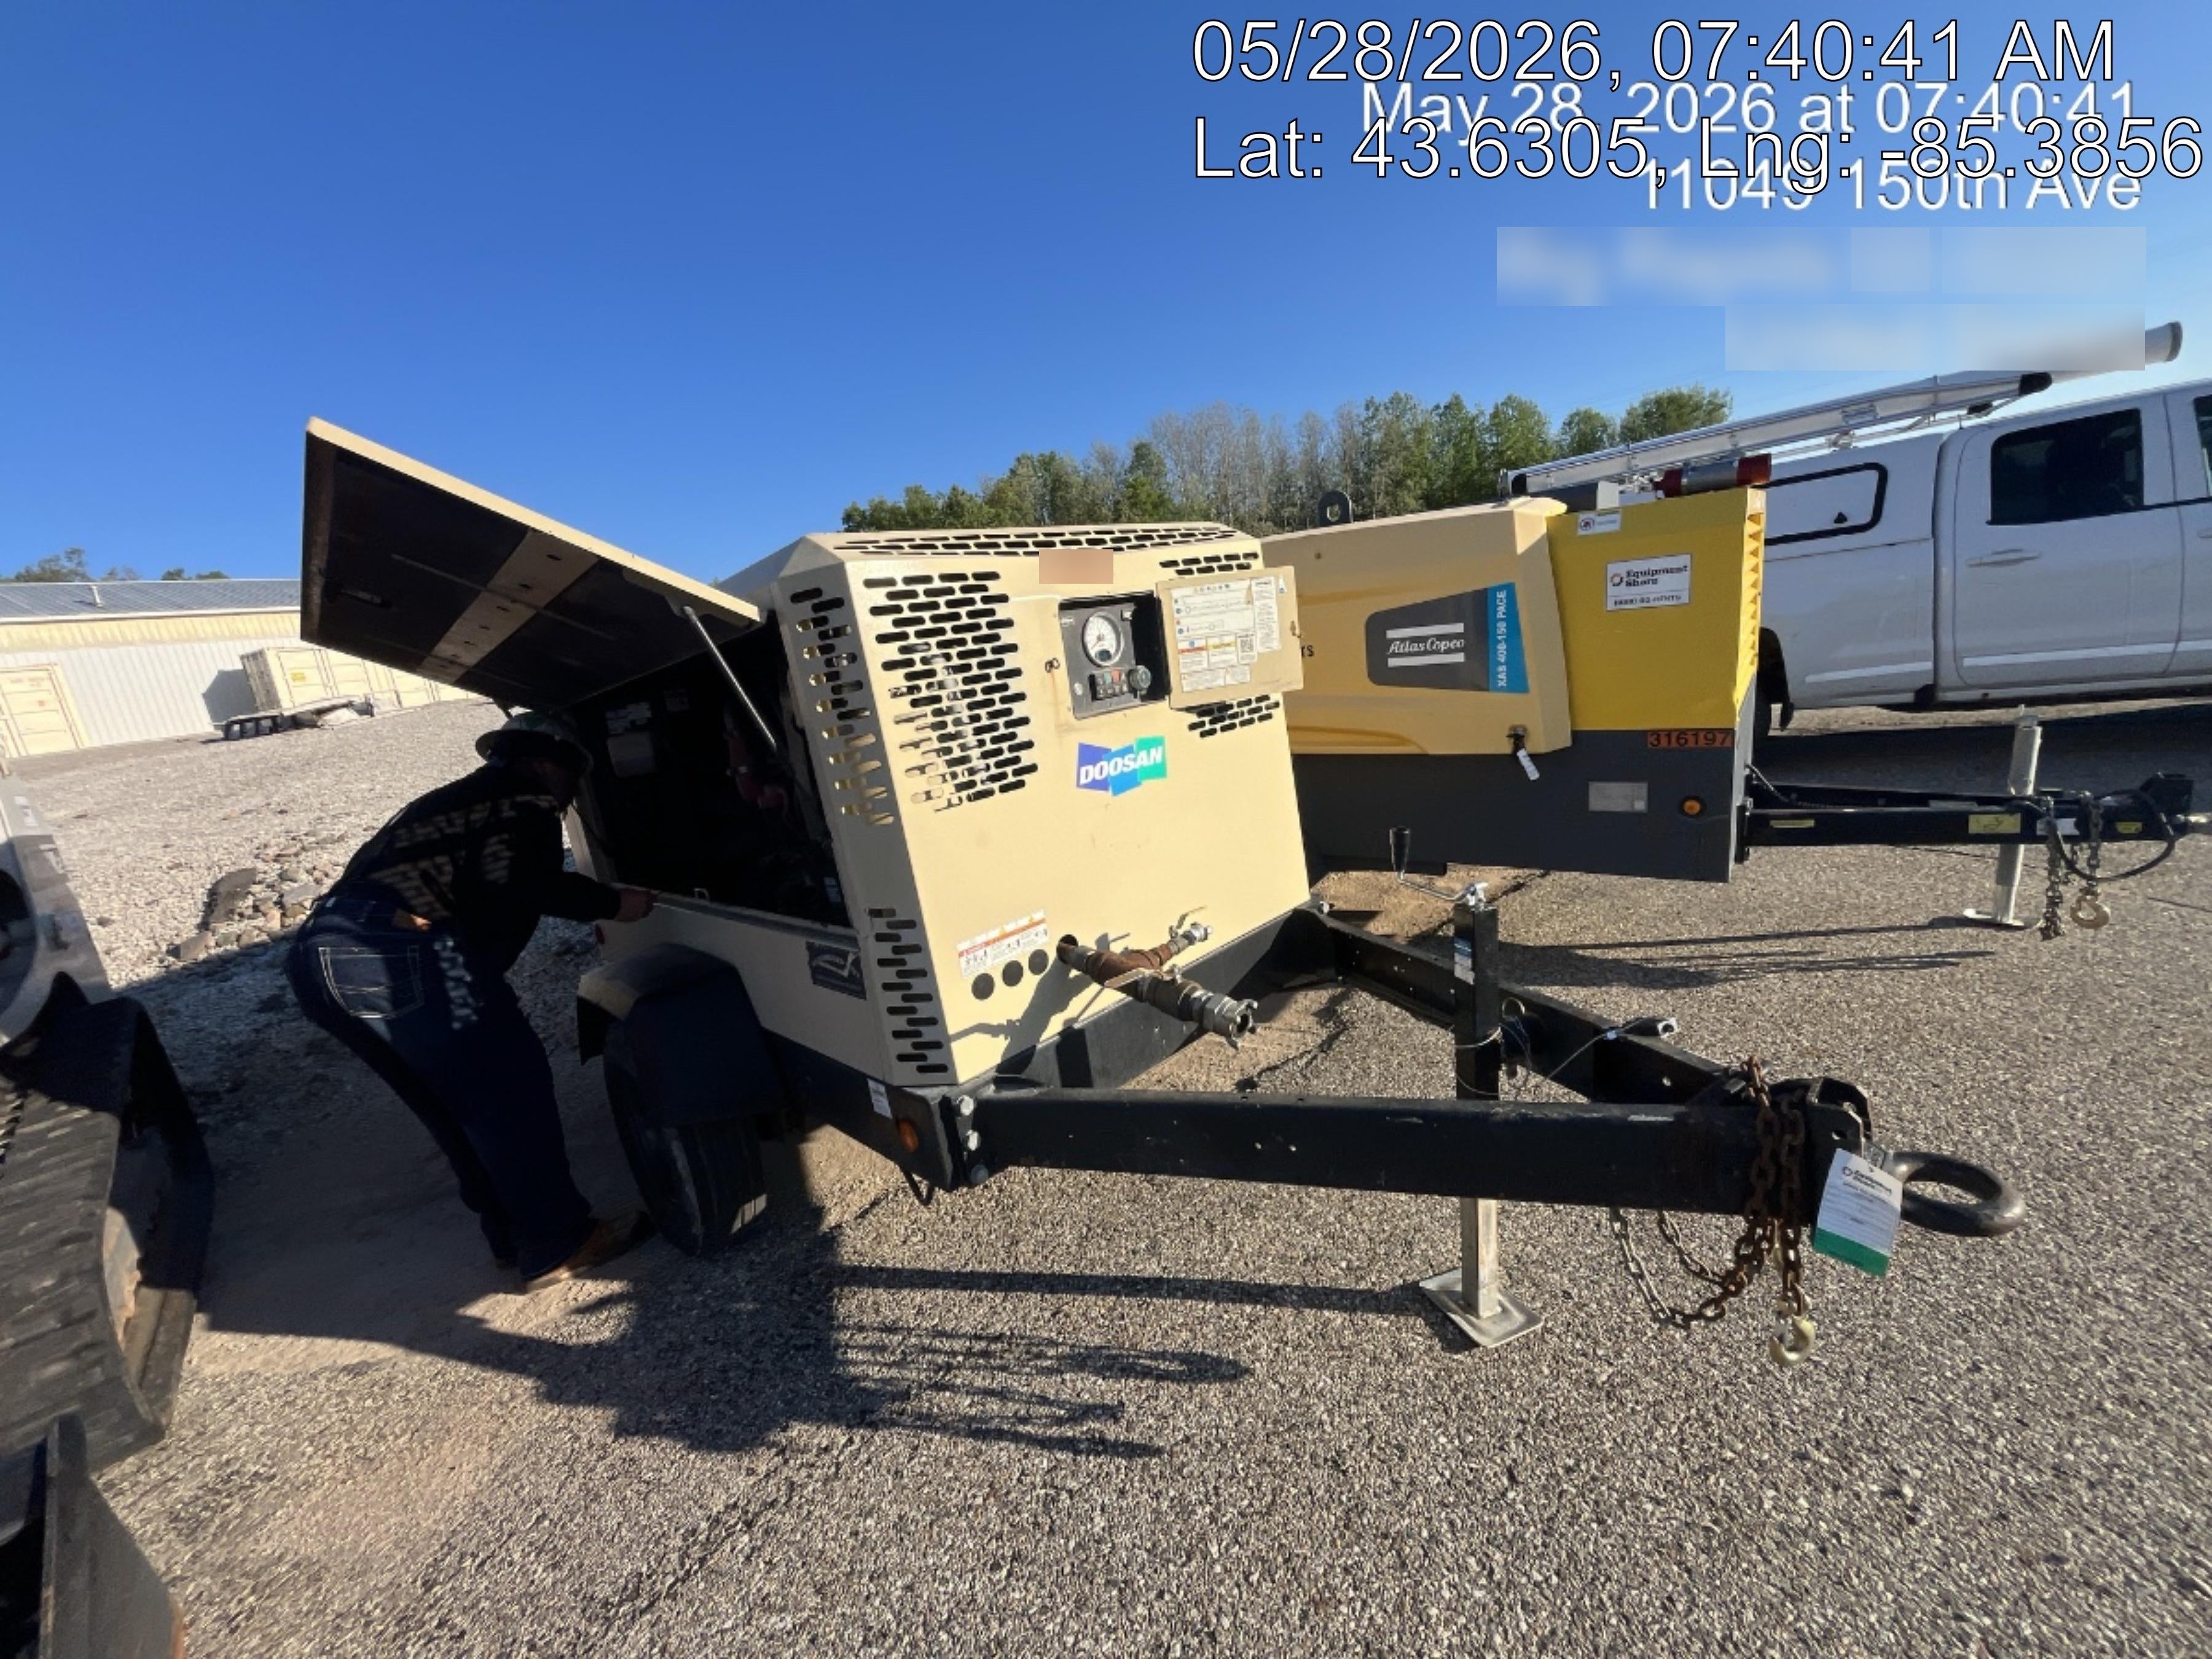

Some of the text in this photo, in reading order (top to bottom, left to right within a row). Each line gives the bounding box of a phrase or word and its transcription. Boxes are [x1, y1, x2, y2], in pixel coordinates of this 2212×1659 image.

[1387, 637, 1464, 655] Atlas Copco
[1649, 731, 1732, 748] 316197
[1079, 745, 1164, 786] DOOSAN
